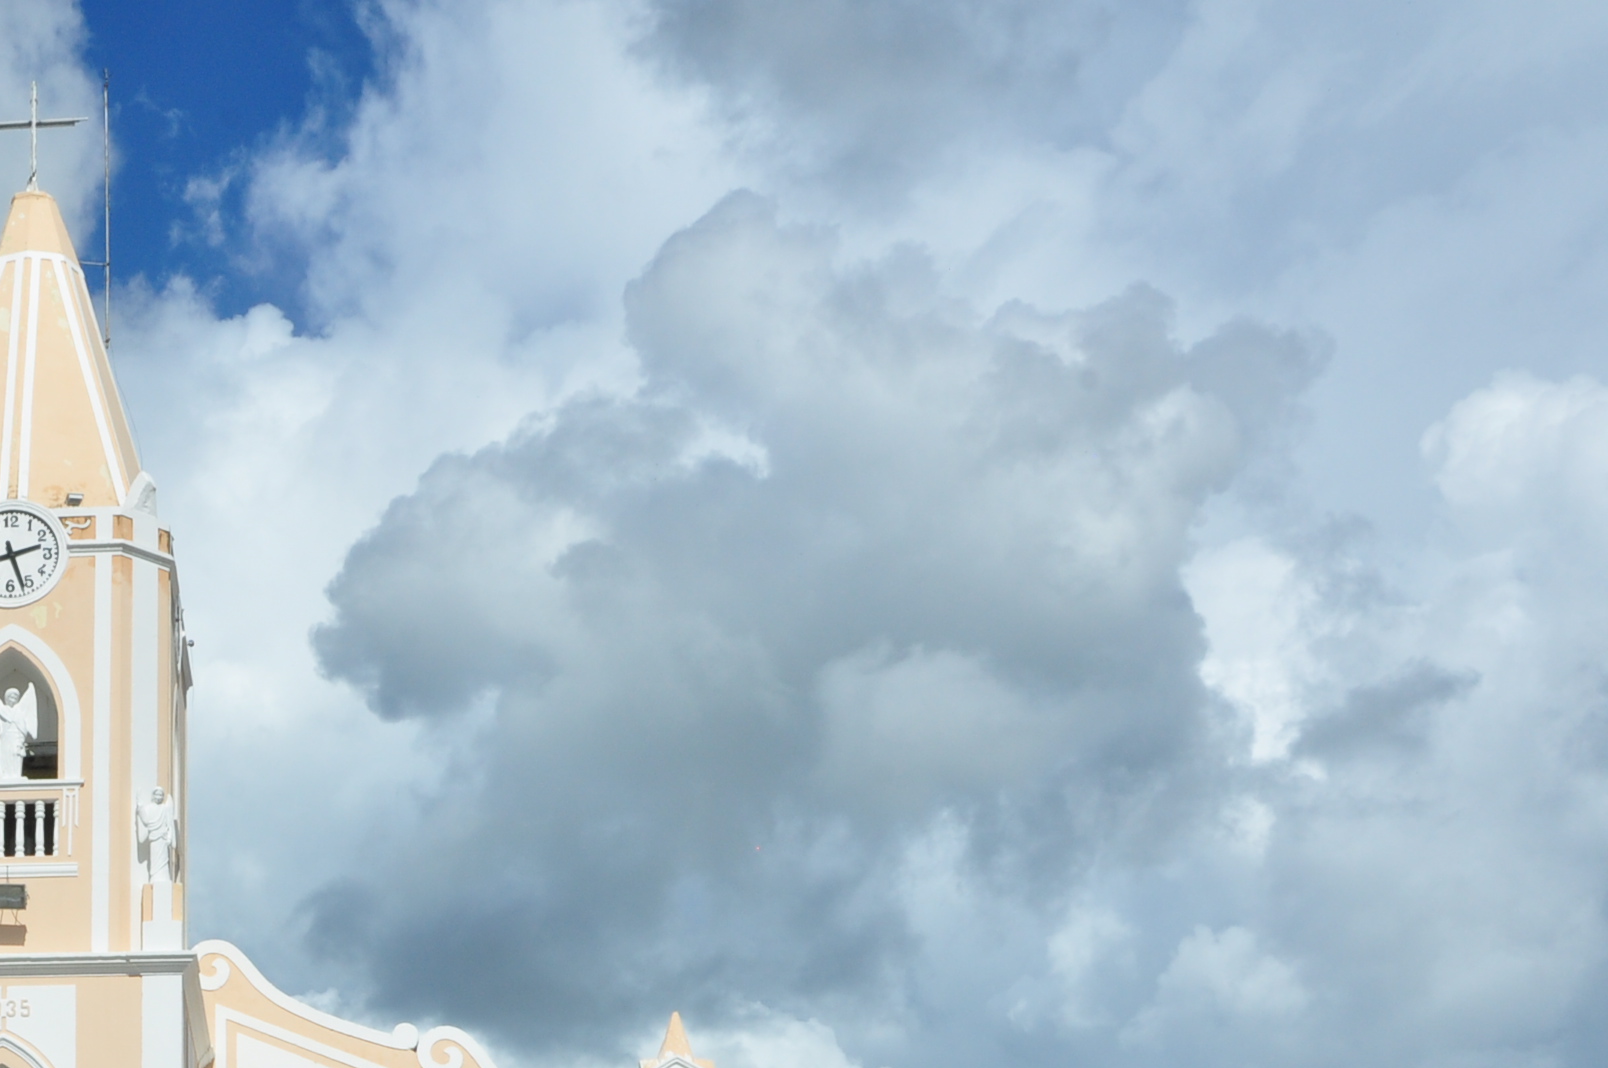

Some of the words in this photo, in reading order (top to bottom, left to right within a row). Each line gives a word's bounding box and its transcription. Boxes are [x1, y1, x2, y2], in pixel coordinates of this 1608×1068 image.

[4, 515, 19, 528] 12
[27, 519, 33, 531] 1
[38, 530, 47, 542] 2
[43, 548, 52, 560] 3
[37, 564, 46, 576] 4
[6, 579, 15, 592] 6
[24, 575, 34, 588] 5
